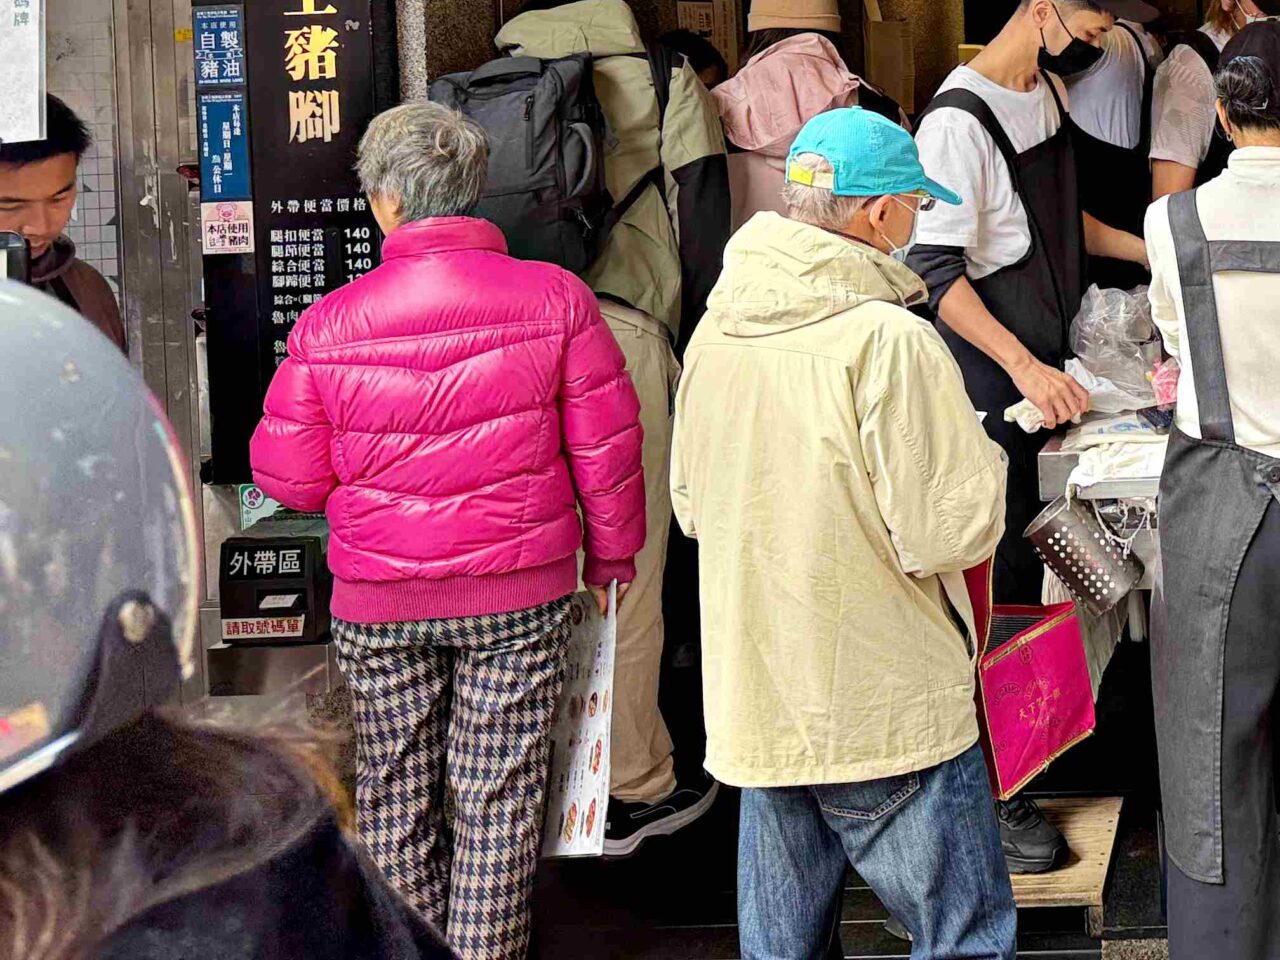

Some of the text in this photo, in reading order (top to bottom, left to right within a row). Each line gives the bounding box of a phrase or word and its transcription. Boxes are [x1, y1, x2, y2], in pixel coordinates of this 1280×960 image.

[201, 31, 240, 50] 自製
[200, 60, 241, 80] 豬油
[270, 198, 367, 214] 外帶便當價格
[208, 222, 249, 234] 本店使用
[344, 227, 370, 239] 140
[344, 242, 371, 254] 140
[271, 258, 372, 273] 綜合便當 140
[229, 549, 301, 576] 外帶區
[226, 619, 301, 636] 請取號碼單
